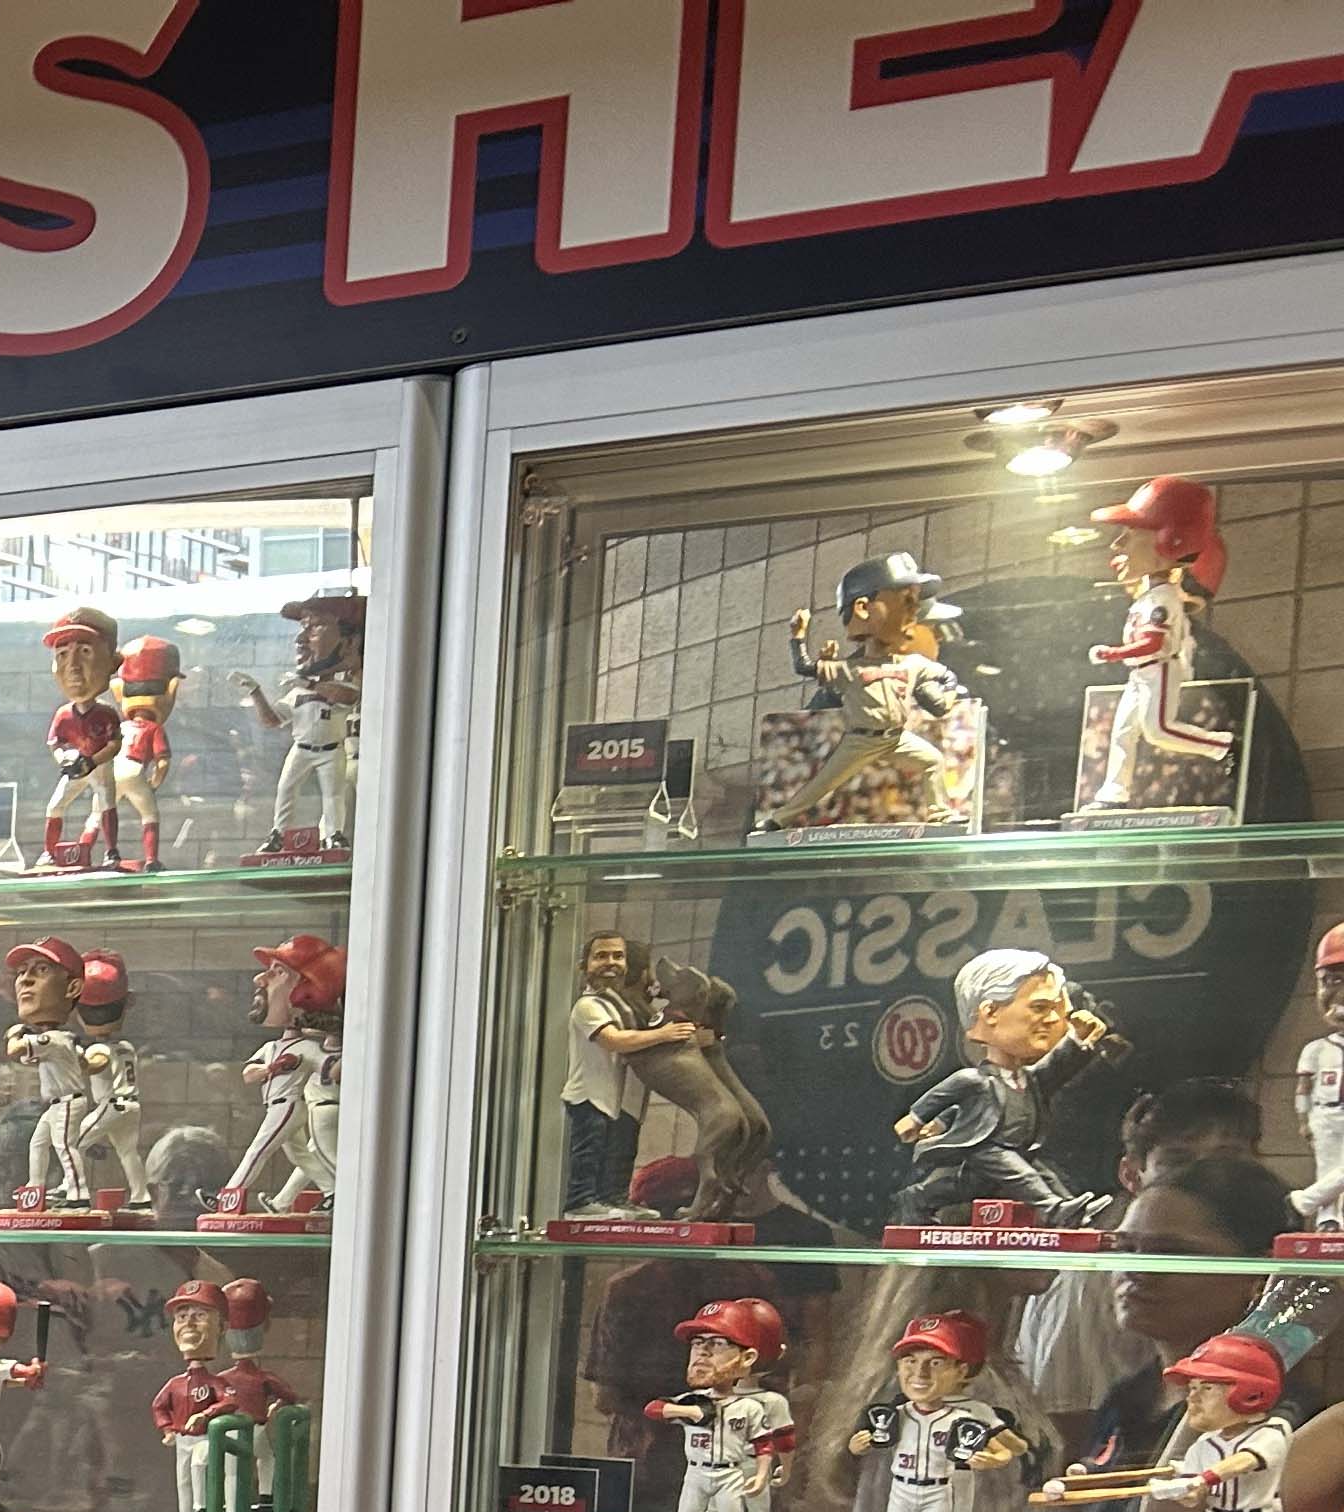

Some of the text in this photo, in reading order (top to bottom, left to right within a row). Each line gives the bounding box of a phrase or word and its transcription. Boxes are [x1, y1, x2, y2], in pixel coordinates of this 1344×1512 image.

[587, 738, 646, 760] 2015
[919, 1230, 1061, 1247] HERBERT HOOVER
[518, 1484, 576, 1506] 2018
